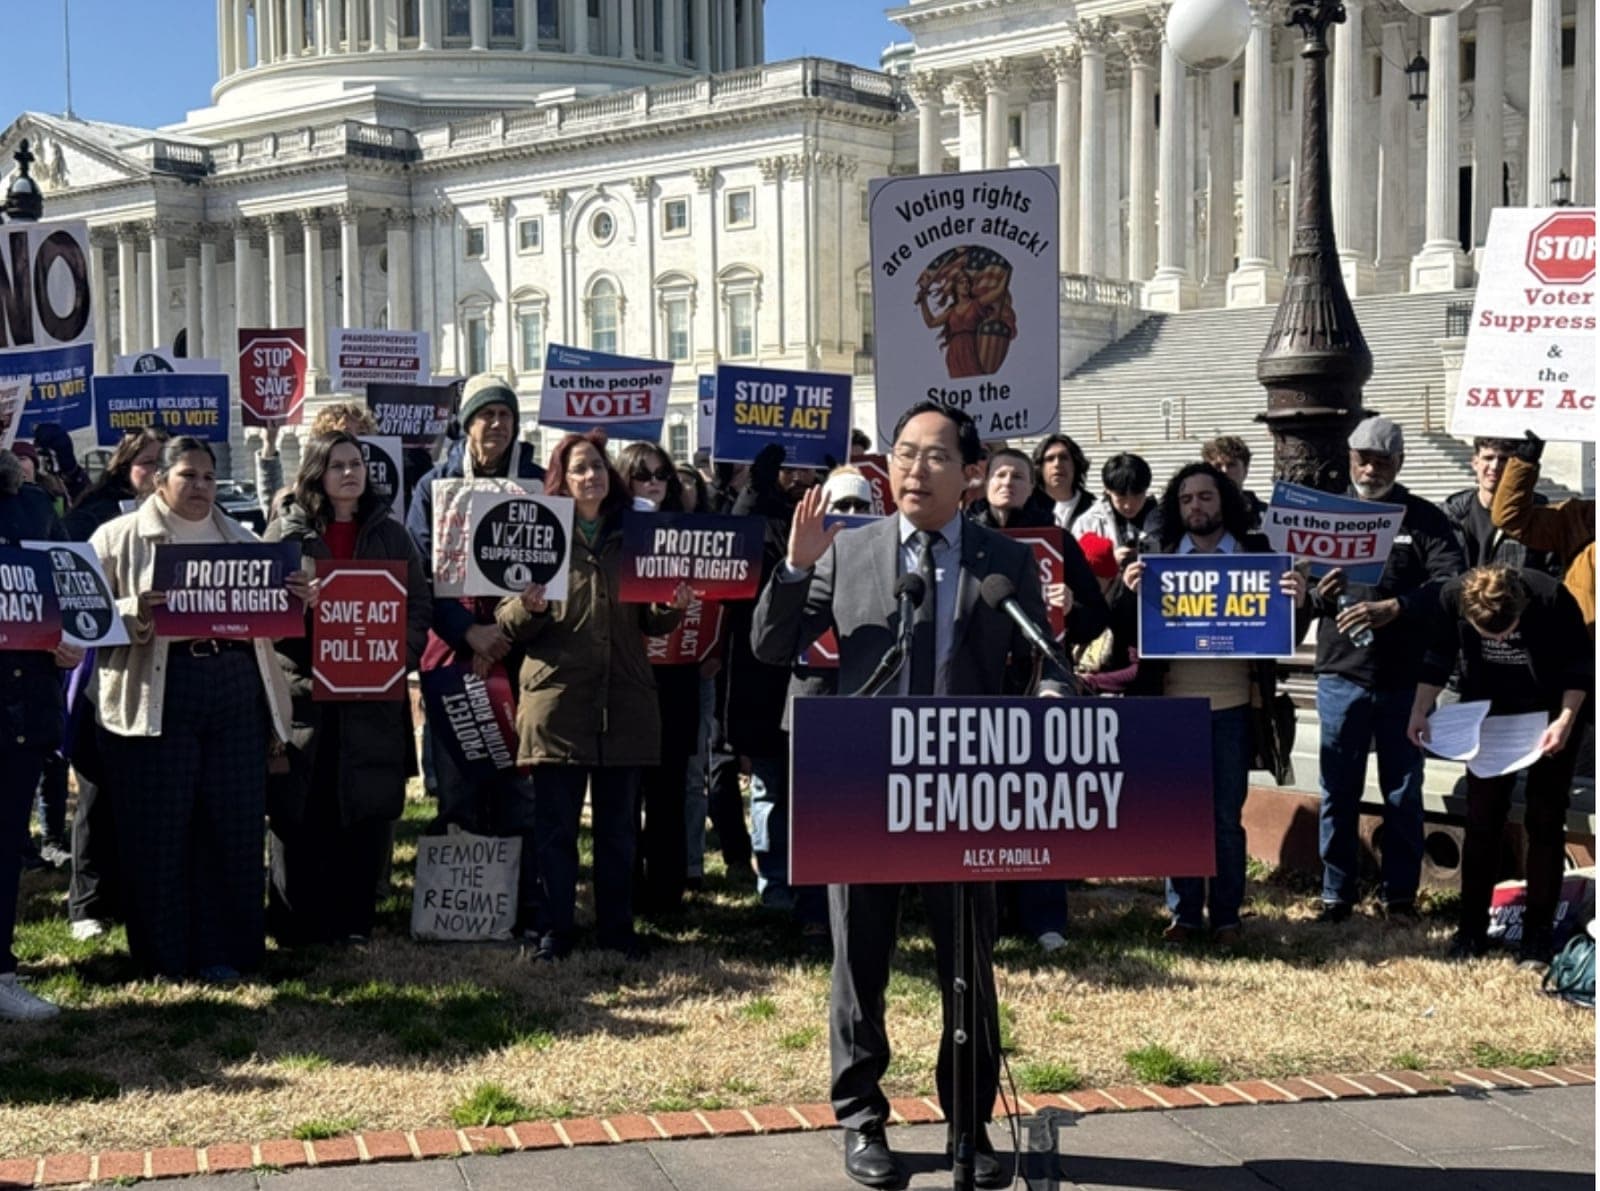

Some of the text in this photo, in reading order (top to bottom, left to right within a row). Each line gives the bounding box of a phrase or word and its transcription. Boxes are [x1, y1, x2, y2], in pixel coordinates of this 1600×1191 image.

[895, 182, 1032, 222] Voting rights
[882, 216, 1049, 277] are under attack!
[1523, 288, 1595, 305] Voter
[253, 347, 292, 368] STOP
[1546, 344, 1563, 359] &
[549, 372, 664, 391] Let the people
[1538, 368, 1569, 383] the
[38, 383, 57, 400] TO
[60, 379, 86, 398] VOTE
[735, 380, 834, 408] STOP THE
[927, 382, 1011, 409] Stop the
[1466, 387, 1544, 408] SAVE
[108, 397, 218, 411] EQUALITY INCLUDES THE
[263, 396, 286, 410] ACT
[375, 403, 435, 420] STUDENTS
[568, 392, 648, 416] VOTE
[110, 410, 219, 428] RIGHT TO VOTE
[734, 402, 785, 427] SAVE
[789, 407, 832, 431] ACT
[990, 409, 1029, 433] Act!
[508, 502, 539, 522] END
[1272, 511, 1393, 533] Let the people
[480, 545, 558, 565] SUPPRESSION
[653, 528, 736, 558] PROTECT
[1290, 531, 1372, 557] VOTE
[50, 551, 77, 571] END
[635, 555, 750, 581] VOTING RIGHTS
[0, 563, 39, 593] OUR
[185, 559, 273, 588] PROTECT
[1161, 570, 1271, 593] STOP THE
[165, 588, 290, 613] VOTING RIGHTS
[320, 600, 400, 624] SAVE ACT
[1161, 593, 1271, 617] SAVE ACT
[354, 626, 367, 636] =
[679, 598, 703, 657] AVE ACT
[320, 638, 399, 662] POLL TAX
[646, 633, 669, 659] AX
[442, 693, 490, 761] PROTECT
[463, 672, 514, 769] VOTING RIGHTS
[890, 706, 1121, 767] DEFEND OUR
[887, 771, 1125, 833] DEMOCRACY
[426, 841, 508, 867] REMOVE
[962, 847, 1051, 867] ALEX PADILLA
[449, 865, 485, 889] THE
[423, 888, 509, 916] REGIME
[433, 912, 497, 935] NOW!
